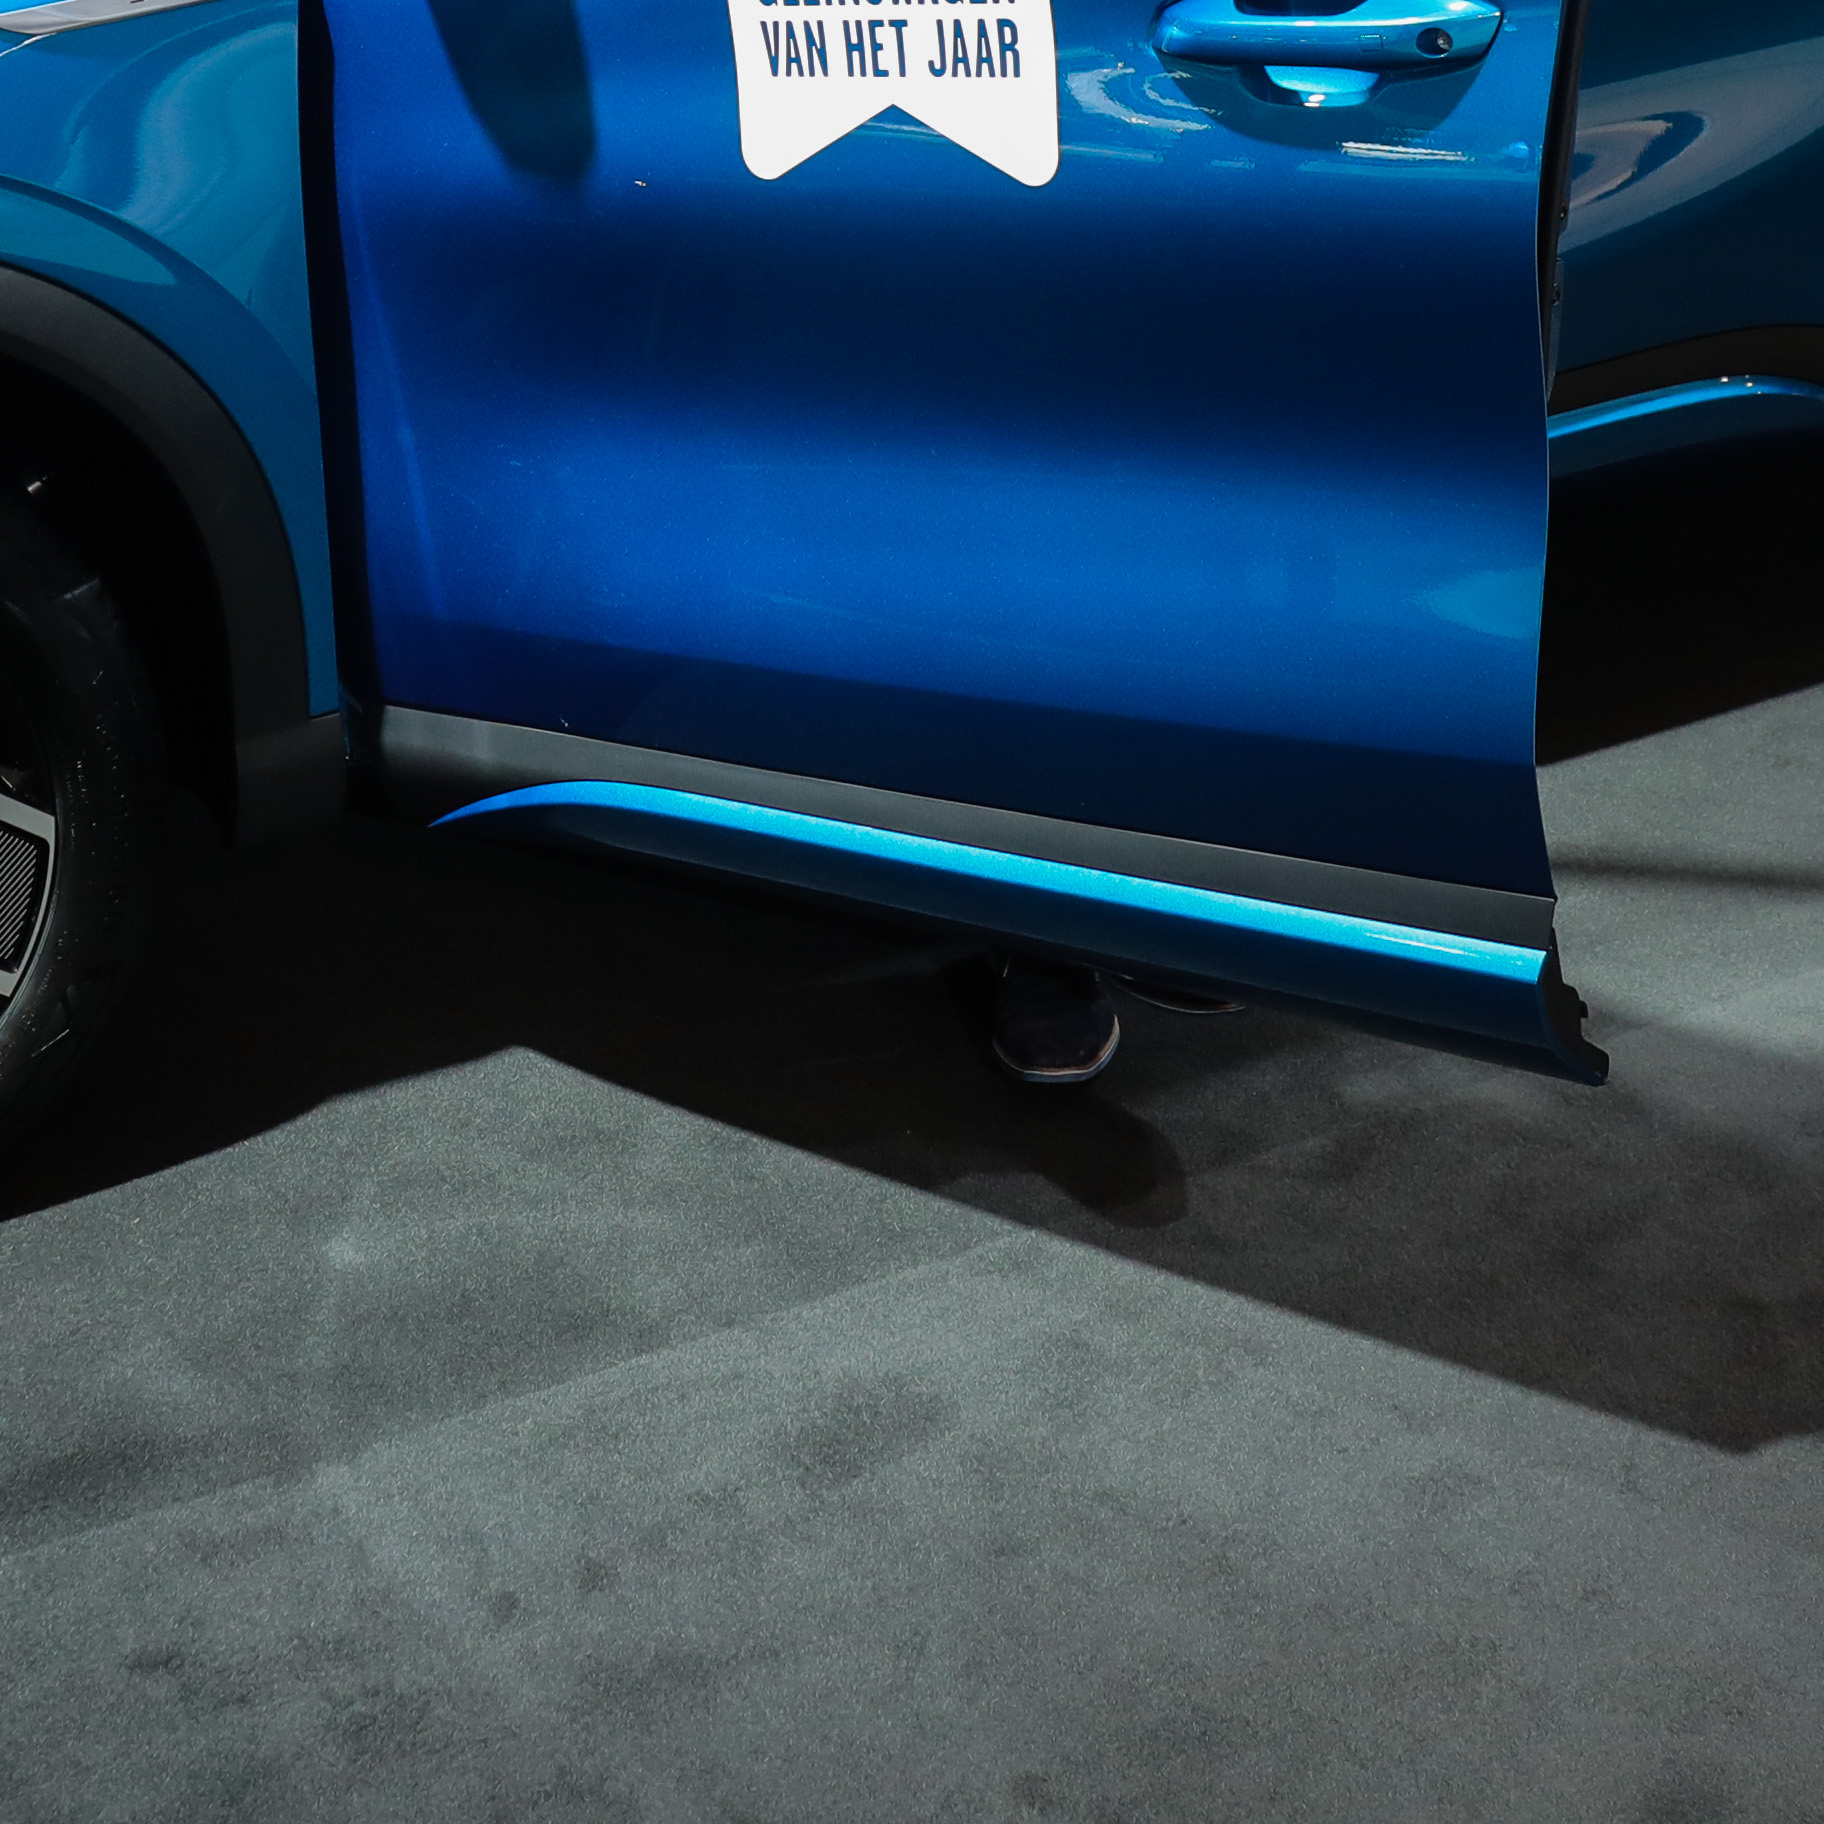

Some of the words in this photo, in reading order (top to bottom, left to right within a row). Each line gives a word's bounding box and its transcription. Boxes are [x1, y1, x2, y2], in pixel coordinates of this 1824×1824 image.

[760, 19, 831, 80] VAN
[846, 20, 910, 78] HET
[927, 19, 1021, 79] JAAR
